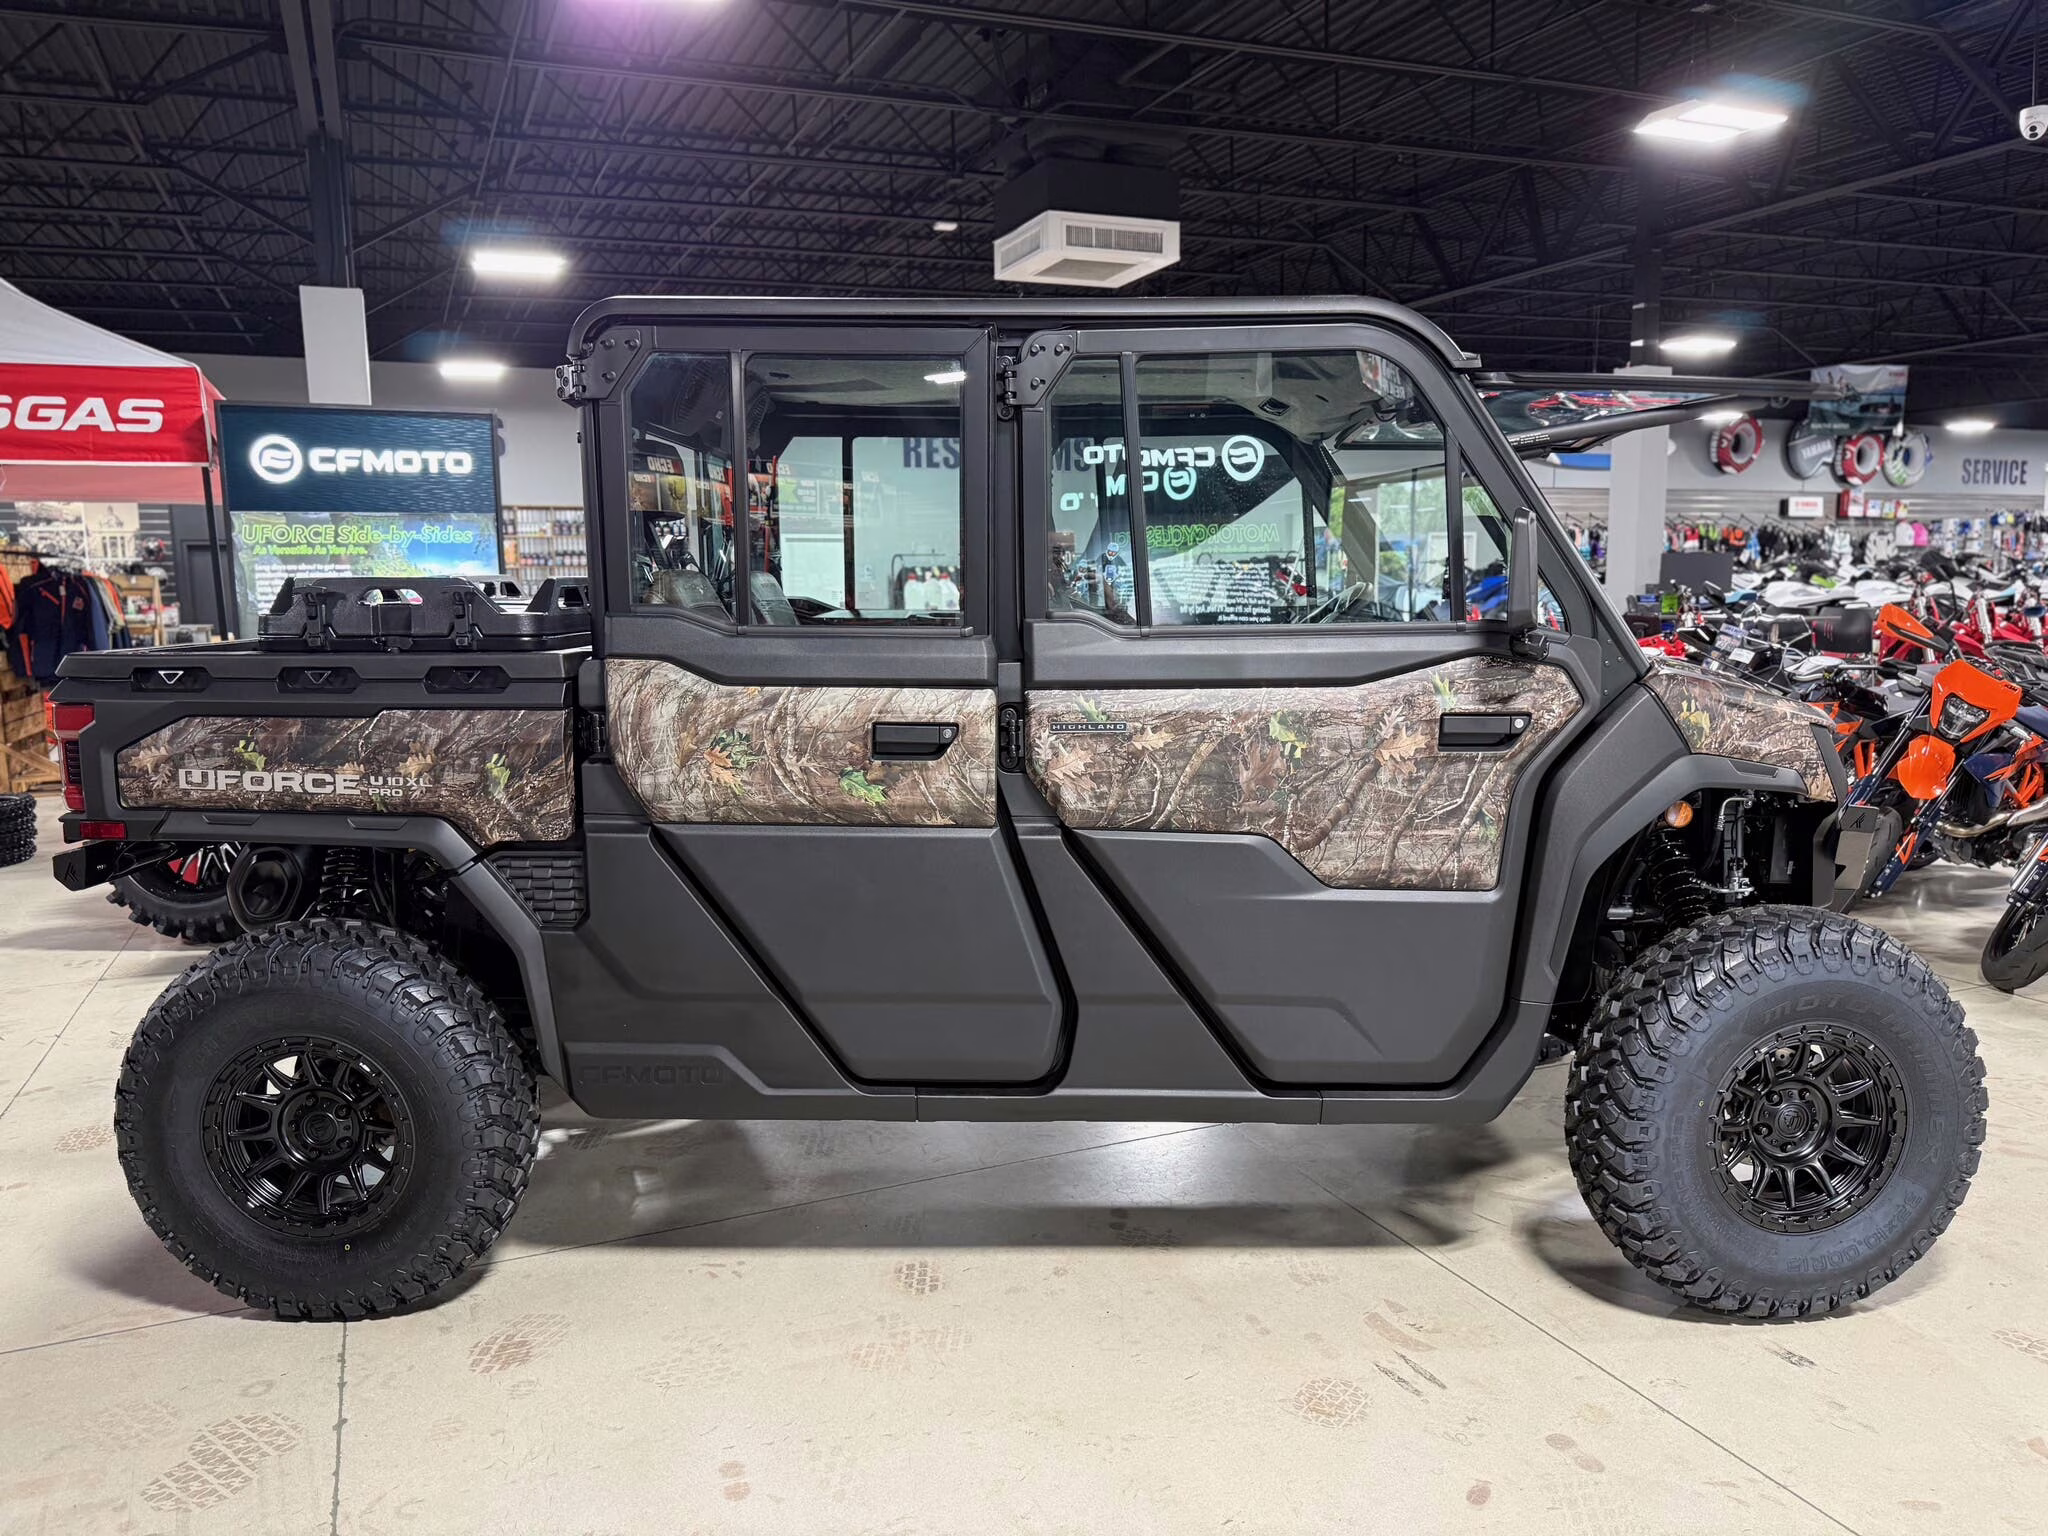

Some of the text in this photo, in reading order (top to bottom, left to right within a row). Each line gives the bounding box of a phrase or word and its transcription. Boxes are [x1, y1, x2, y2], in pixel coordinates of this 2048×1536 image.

[0, 395, 165, 433] GAS
[308, 447, 473, 474] CFMOTO
[1962, 458, 2028, 485] SERVICE
[241, 524, 473, 547] UFORCE Side-by-Sides
[179, 769, 361, 795] UFORCE
[368, 788, 403, 797] PRO
